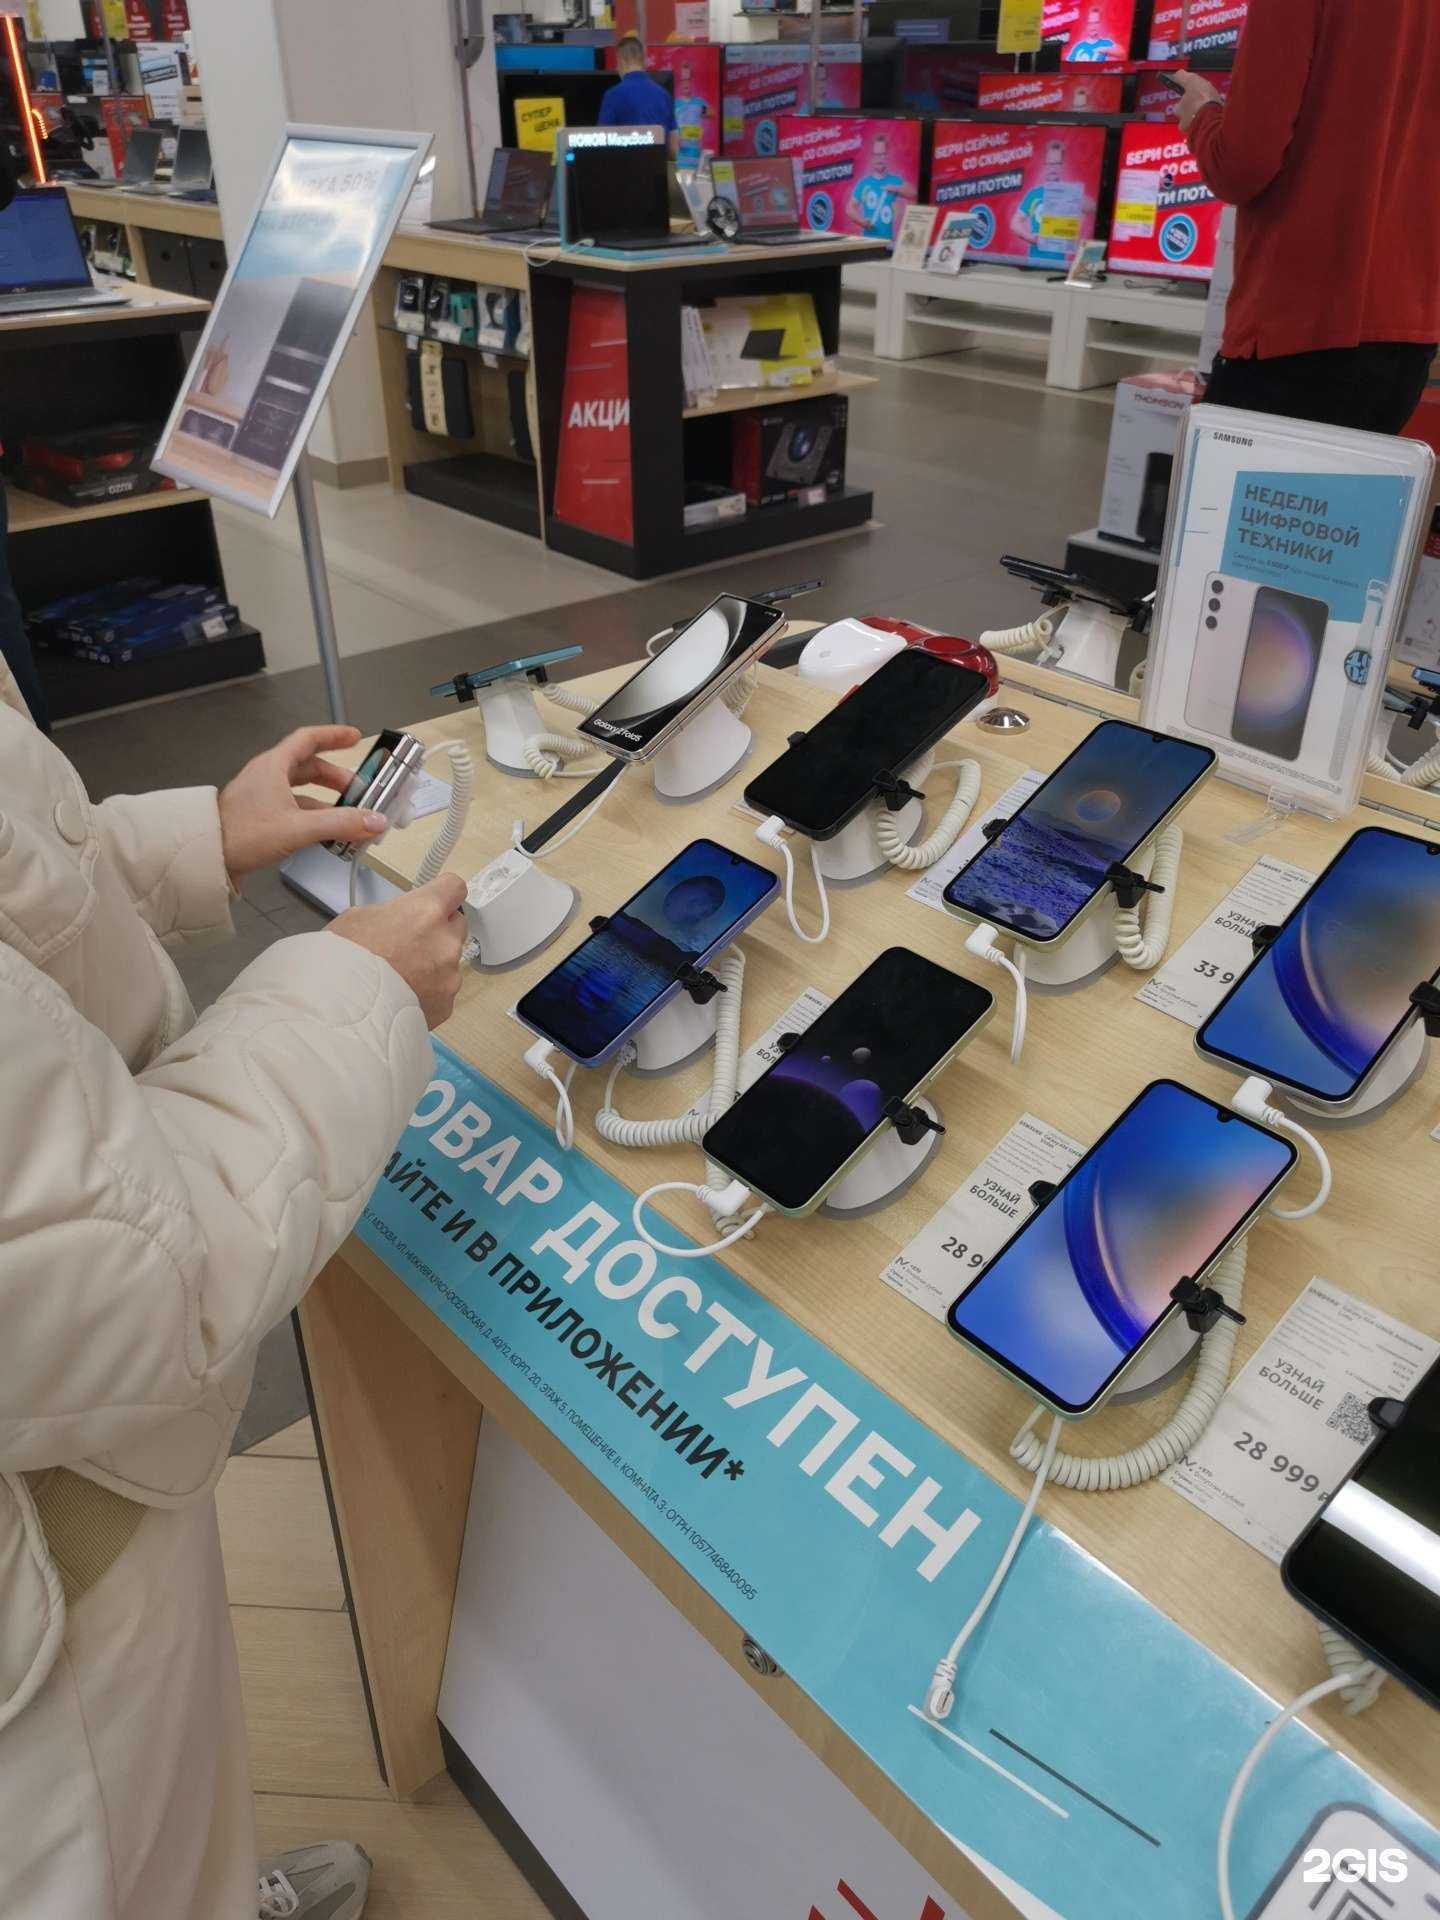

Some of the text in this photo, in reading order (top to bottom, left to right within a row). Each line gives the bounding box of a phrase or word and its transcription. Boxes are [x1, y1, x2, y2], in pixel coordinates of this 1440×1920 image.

[1194, 30, 1238, 50] ПОТОМ
[521, 107, 552, 122] СУПЕР
[534, 118, 561, 134] ЦЕНА
[568, 131, 655, 147] HONOR MagicBook
[934, 131, 1010, 160] БЕРИ СЕЙЧАС
[962, 141, 1034, 170] СО СКИДКОЙ
[1126, 147, 1161, 166] БЕРИ
[816, 164, 853, 182] ПОТОМ
[936, 173, 1023, 202] ПЛАТИ ПОТОМ
[567, 398, 630, 432] АКЦИ
[1134, 393, 1185, 410] THOMSON
[1212, 431, 1254, 447] SAMSUNG
[1244, 483, 1329, 517] НЕДЕЛИ
[1241, 506, 1361, 548] ЦИФРОВОЙ
[1237, 527, 1334, 564] ТЕХНИКИ
[594, 718, 620, 733] Galaxy
[622, 730, 643, 742] Fold5
[1194, 960, 1235, 985] 33 9
[970, 1185, 1018, 1218] БОЛЬШЕ
[983, 1178, 1021, 1204] УЗНАЙ
[441, 1209, 477, 1243] И
[465, 1231, 498, 1262] В
[941, 1237, 988, 1268] 28 9
[1259, 1366, 1325, 1410] БОЛЬШЕ
[1275, 1357, 1326, 1393] УЗНАЙ
[530, 1201, 982, 1583] ДОСТУПЕН
[1233, 1432, 1268, 1460] 28
[1270, 1455, 1320, 1494] 999
[540, 1383, 562, 1408] ЭТАЖ
[565, 1408, 617, 1461] ПОМЕЩЕНИЕ
[619, 1463, 660, 1505] КОМНАТА
[665, 1508, 691, 1536] ОГРН
[688, 1530, 758, 1601] 1057746840095
